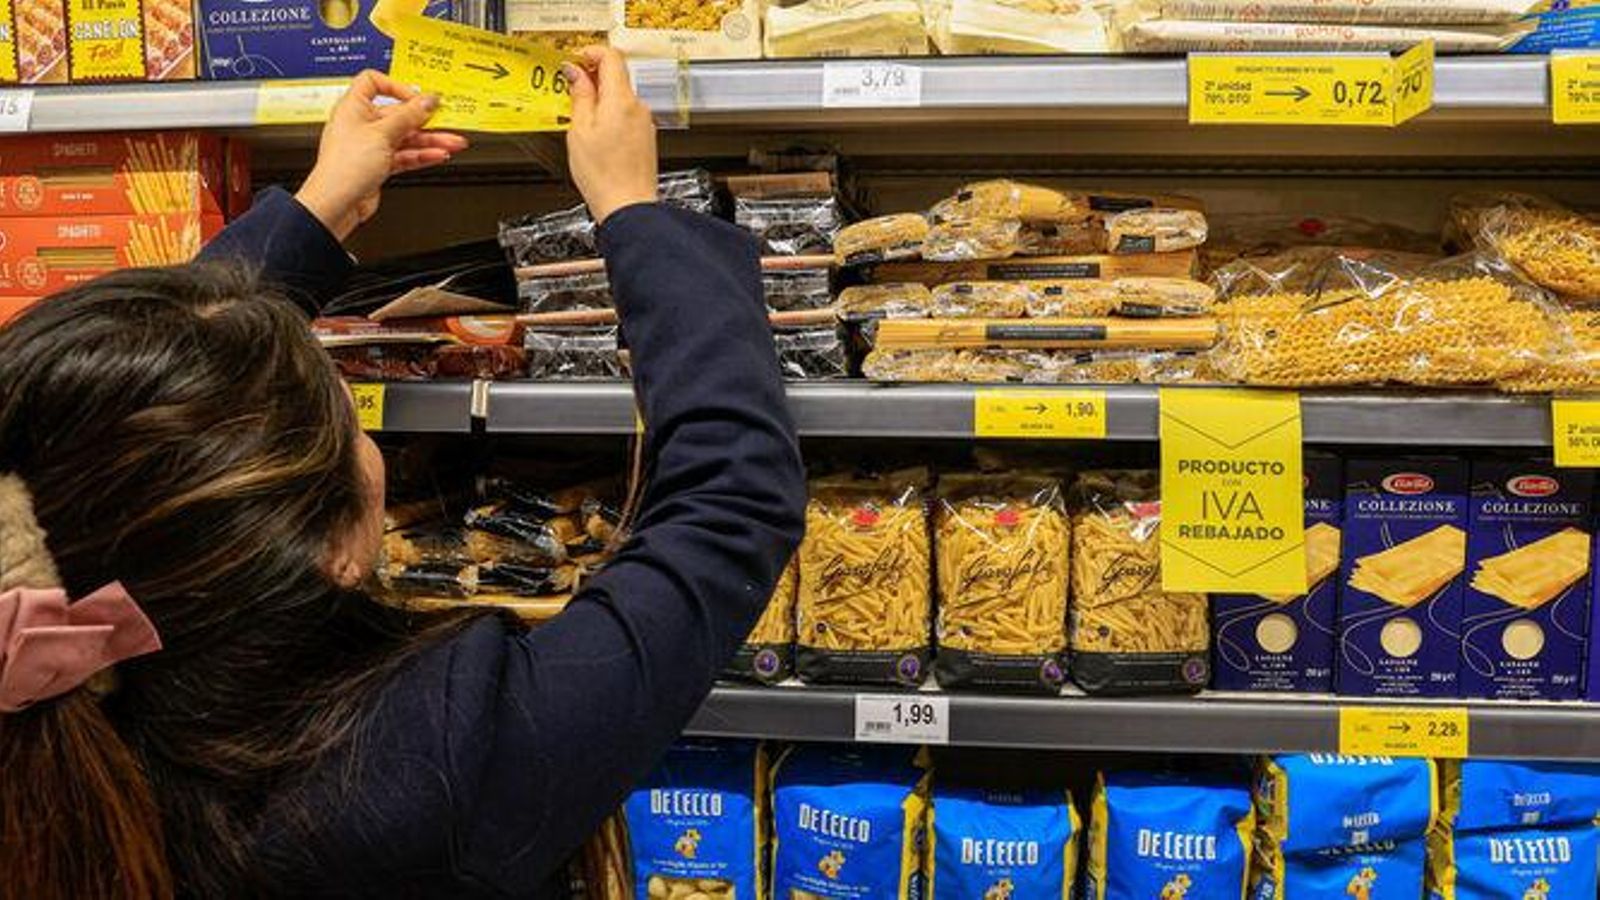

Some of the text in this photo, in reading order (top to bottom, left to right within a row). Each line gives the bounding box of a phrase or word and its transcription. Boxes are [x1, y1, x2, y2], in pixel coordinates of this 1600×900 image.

[209, 8, 311, 25] COLLEZIONE
[1178, 459, 1285, 475] PRODUCTO
[1201, 490, 1264, 520] IVA
[1358, 500, 1456, 513] COLLEZIONE
[1482, 502, 1580, 515] COLLEZIONE
[1178, 524, 1285, 540] REBAJADO
